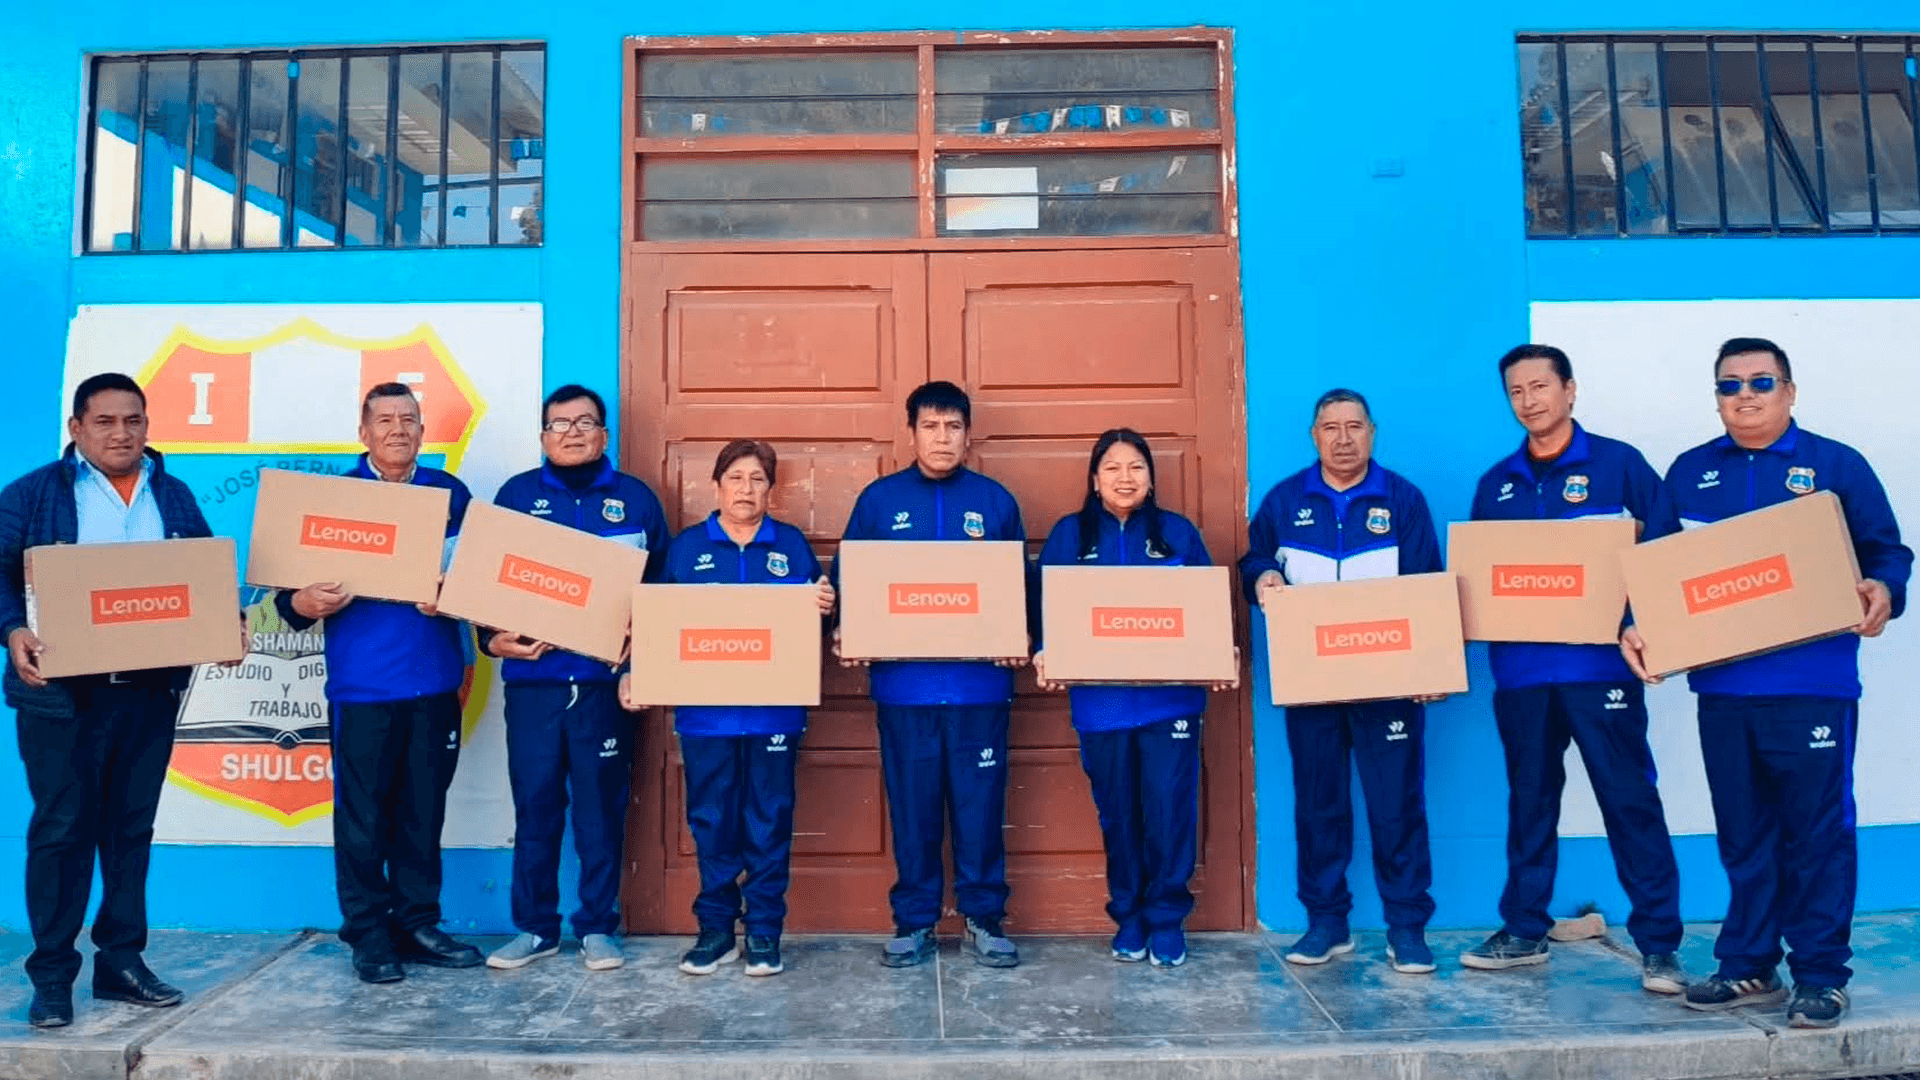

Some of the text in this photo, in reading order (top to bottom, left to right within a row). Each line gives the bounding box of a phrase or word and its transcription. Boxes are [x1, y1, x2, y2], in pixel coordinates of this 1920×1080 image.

[188, 373, 215, 425] I
[309, 522, 387, 546] Lenovo
[507, 562, 581, 597] Lenovo
[1499, 572, 1576, 589] Lenovo
[1691, 568, 1781, 604] Lenovo
[99, 596, 182, 616] Lenovo
[896, 589, 971, 606] Lenovo
[1100, 613, 1175, 630] Lenovo
[687, 636, 764, 653] Lenovo
[1324, 629, 1403, 648] Lenovo
[205, 664, 272, 681] ESTUDIO
[281, 683, 291, 698] Y
[249, 701, 322, 719] TRABAJO
